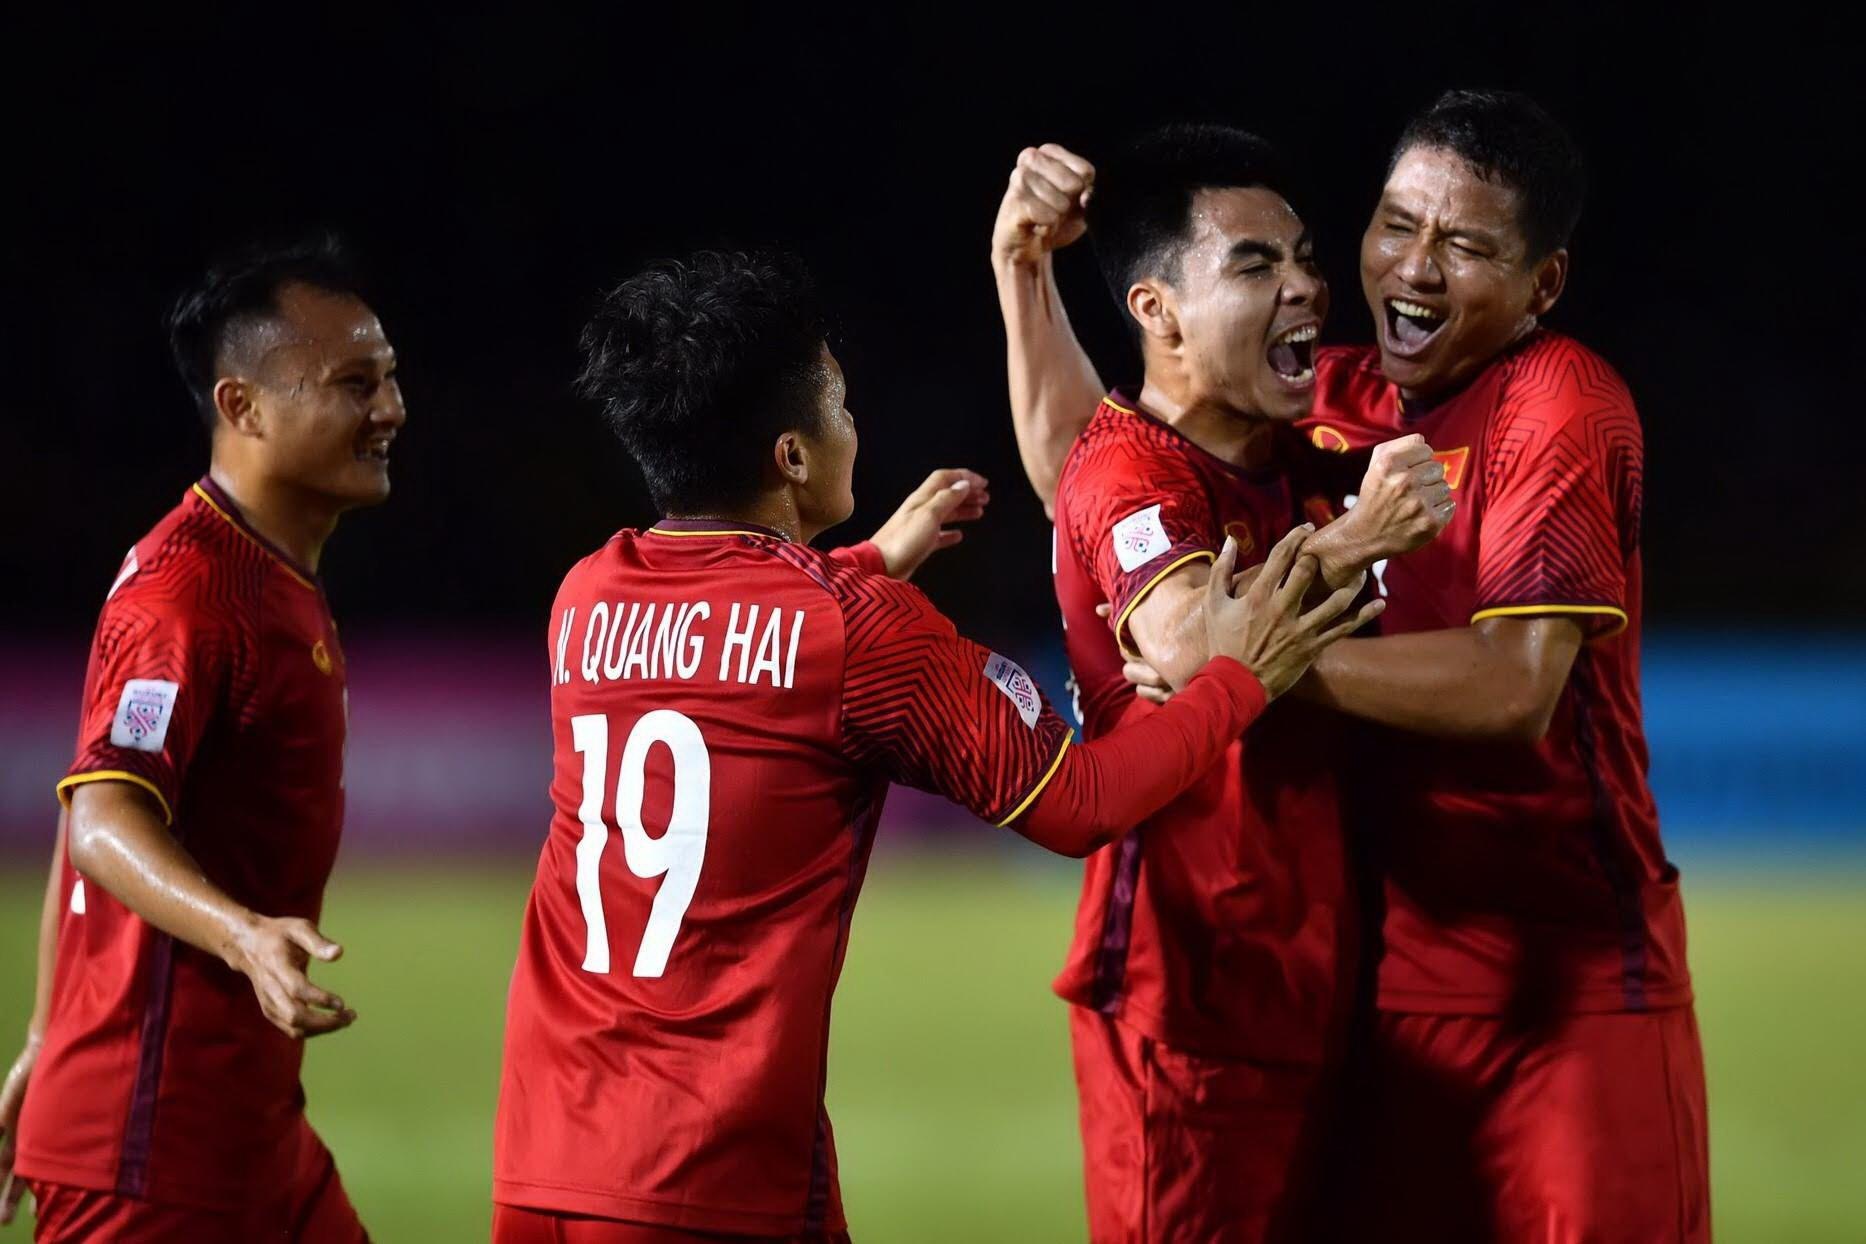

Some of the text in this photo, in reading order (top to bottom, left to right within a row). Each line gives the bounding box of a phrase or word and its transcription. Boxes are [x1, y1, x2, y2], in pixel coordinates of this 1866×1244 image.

[553, 601, 805, 689] N. QUANG HAI
[570, 709, 711, 978] 19
